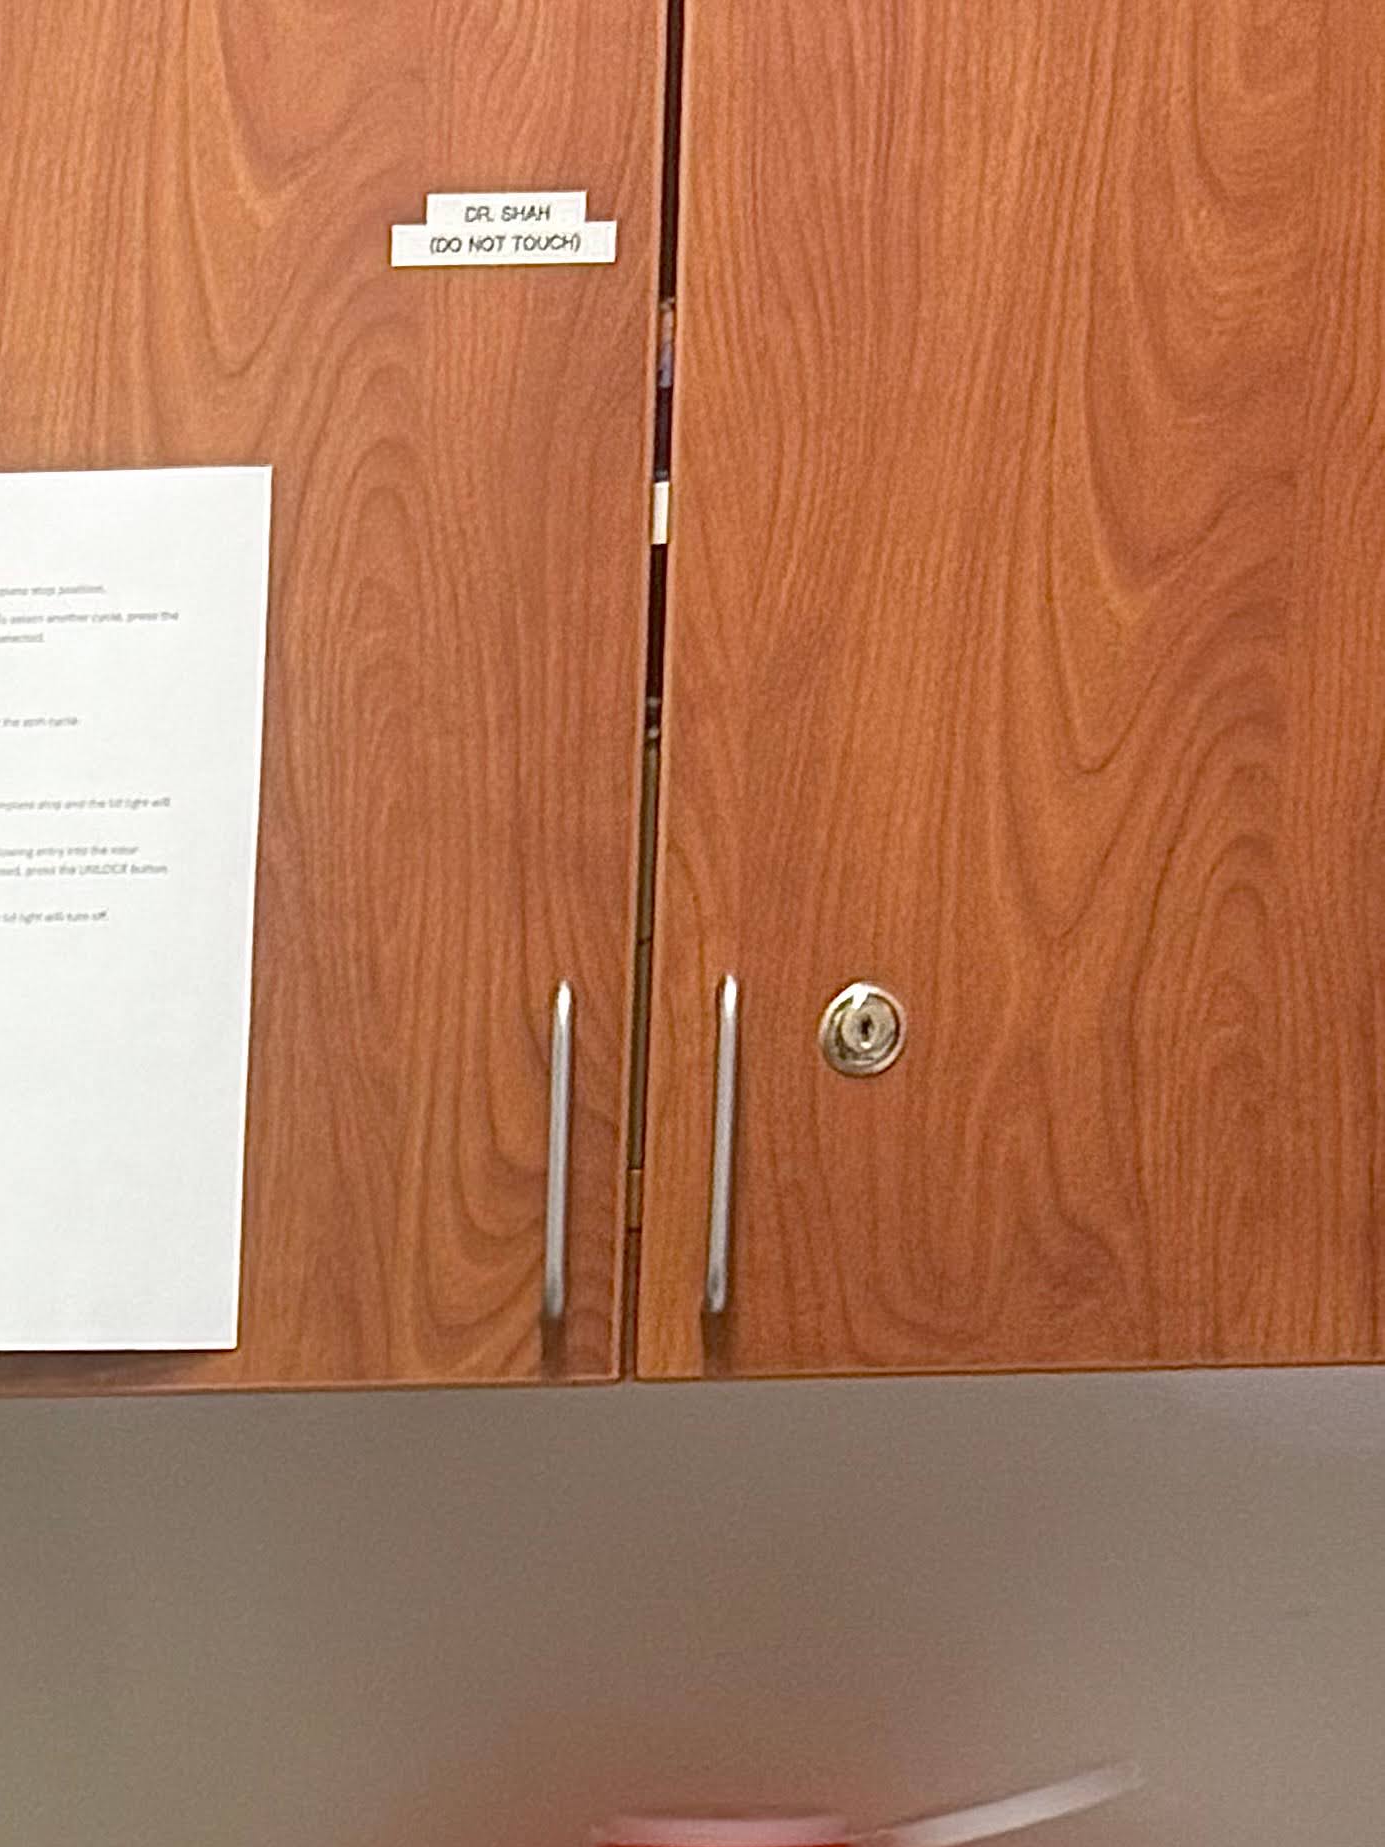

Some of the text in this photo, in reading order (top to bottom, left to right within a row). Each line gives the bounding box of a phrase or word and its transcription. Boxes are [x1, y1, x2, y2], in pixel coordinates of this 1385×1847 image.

[500, 205, 551, 221] SHAH
[429, 233, 582, 255] (DO NOT TOUCH)
